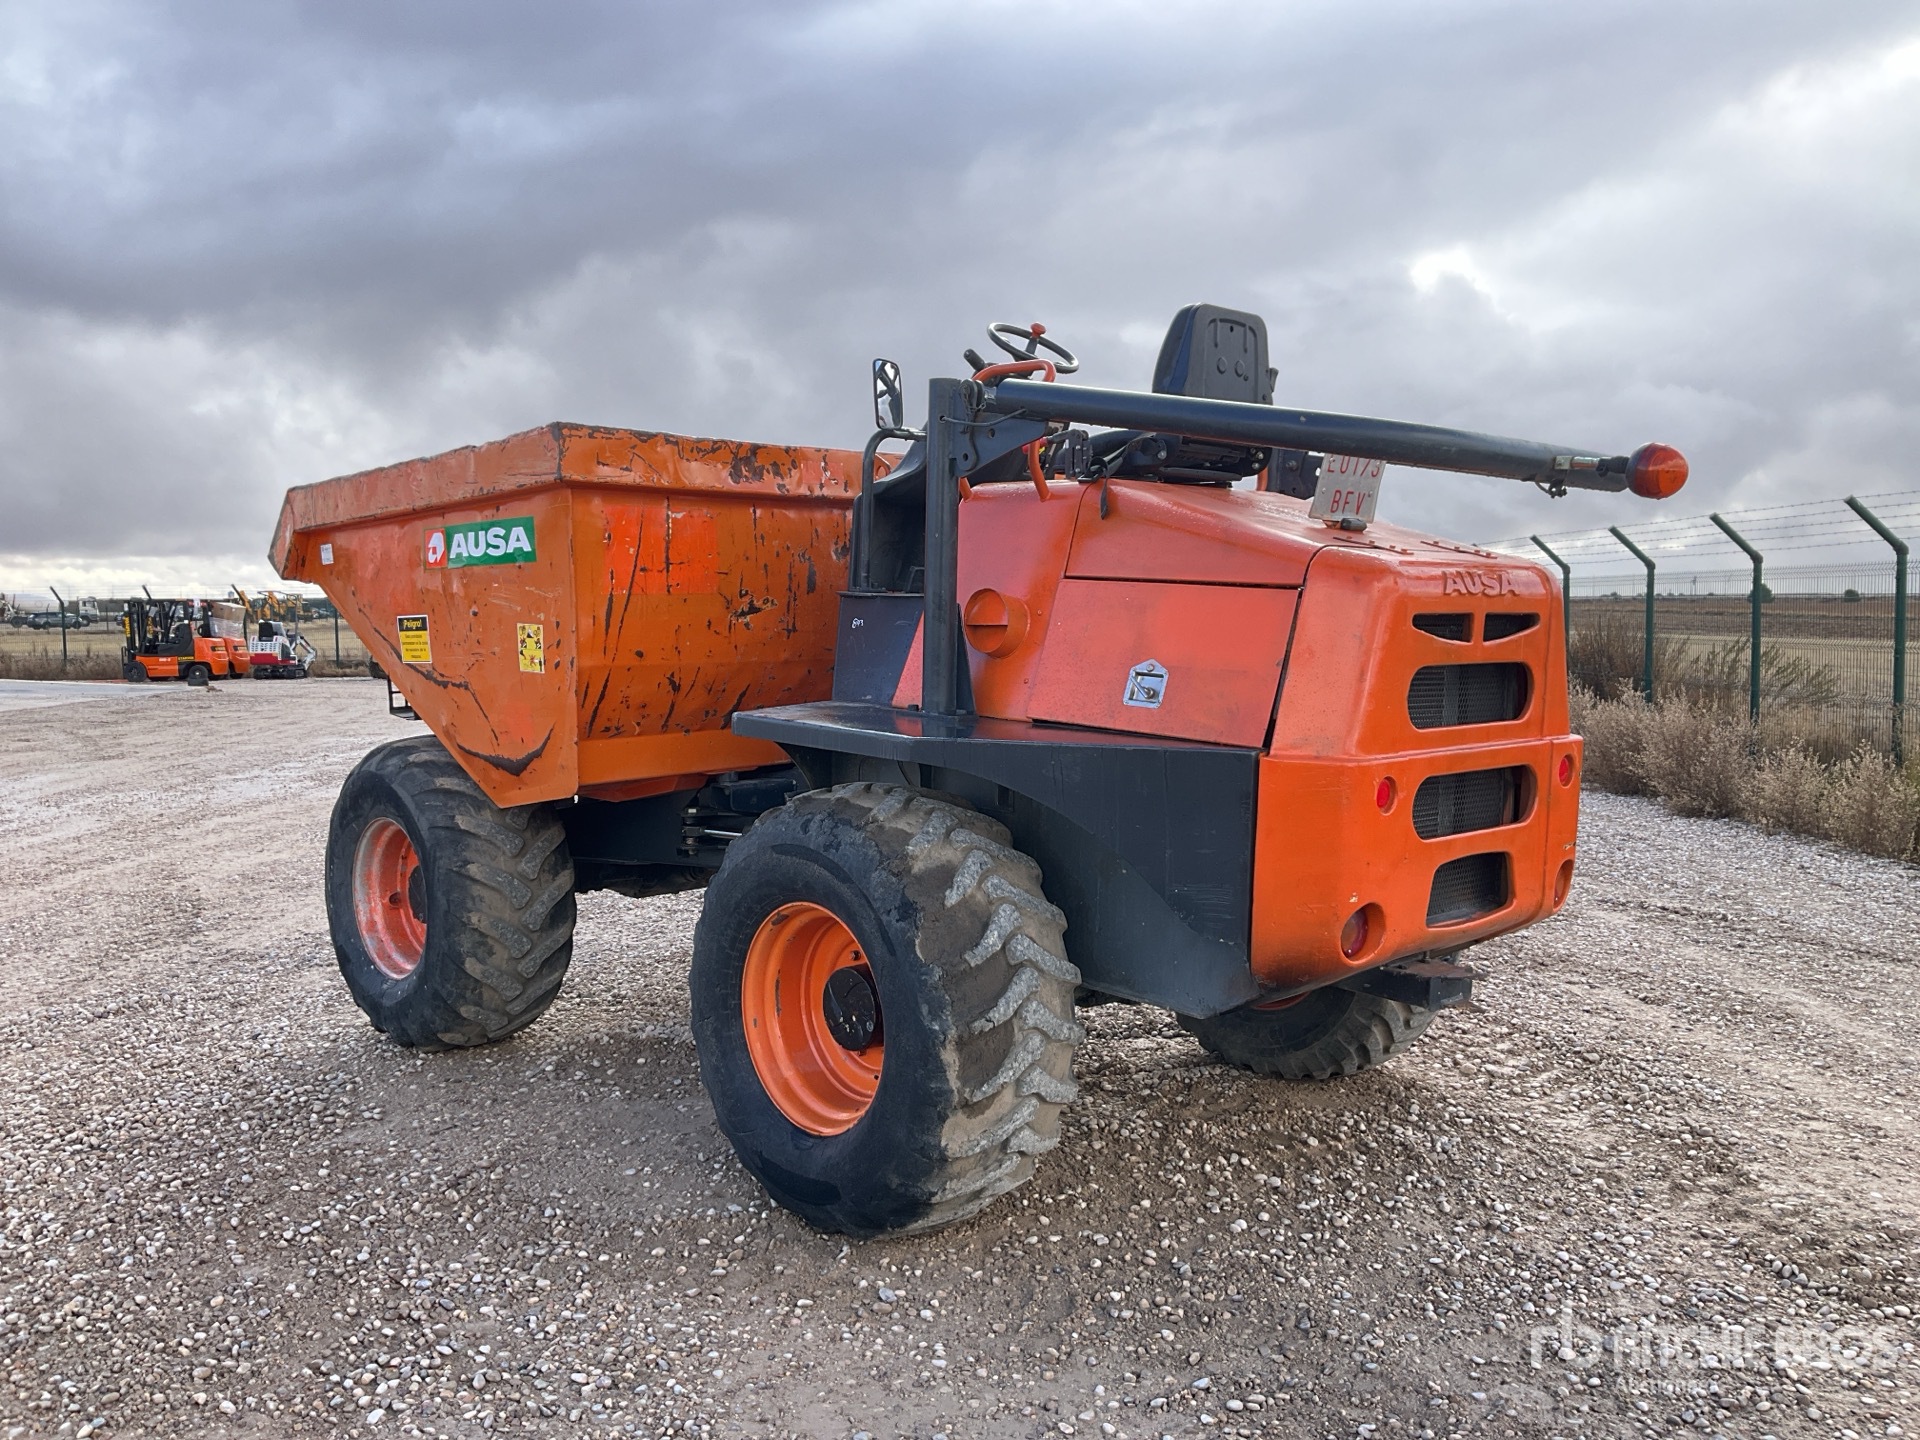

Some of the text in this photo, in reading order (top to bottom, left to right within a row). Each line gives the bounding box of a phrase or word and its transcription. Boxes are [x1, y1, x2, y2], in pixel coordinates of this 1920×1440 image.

[1329, 489, 1366, 516] BFV
[449, 526, 532, 559] AUSA
[1442, 568, 1520, 598] AUSA
